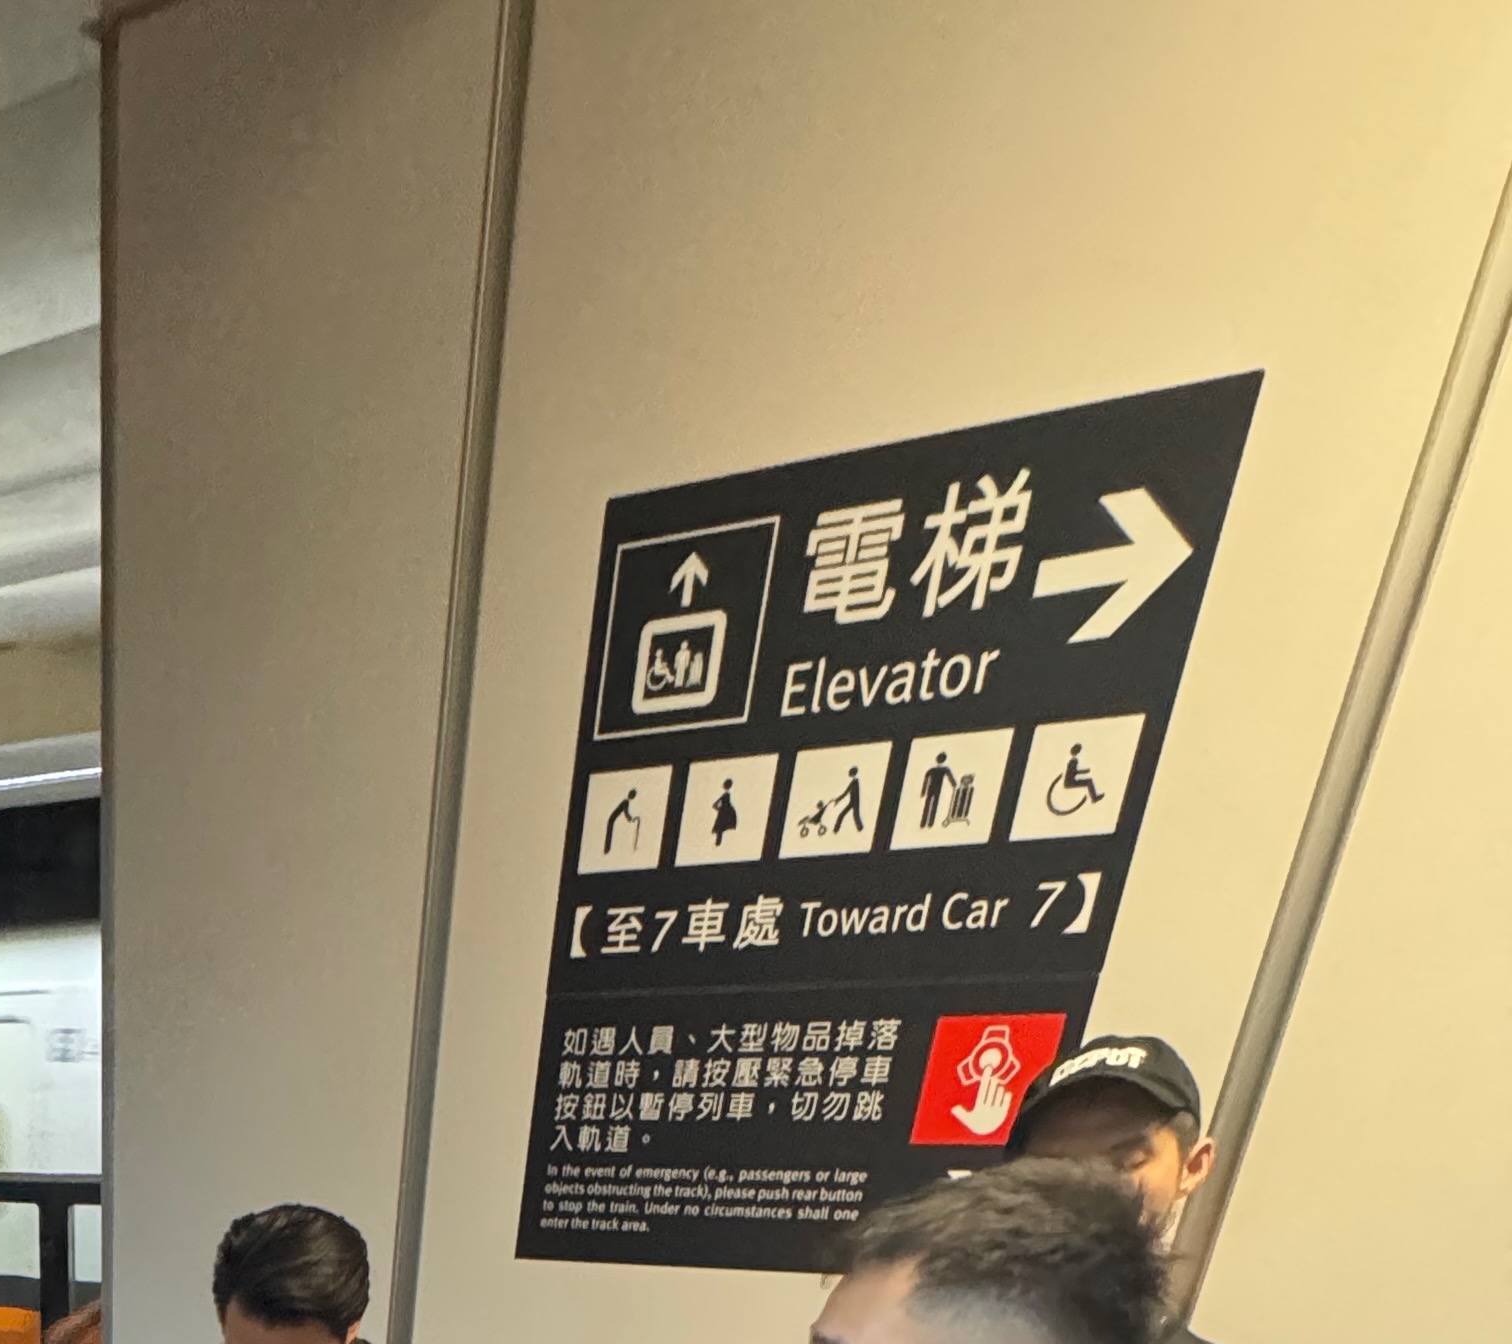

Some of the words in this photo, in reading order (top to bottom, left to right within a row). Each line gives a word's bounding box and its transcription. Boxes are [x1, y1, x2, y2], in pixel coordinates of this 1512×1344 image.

[800, 467, 1032, 625] 電梯
[780, 645, 1001, 718] Elevator
[800, 893, 933, 938] Toward
[941, 893, 1010, 931] Car
[562, 1019, 903, 1056] 如遇人員、大型物品掉落
[558, 1055, 894, 1090] 軌道時，請按壓緊急停車
[553, 1091, 886, 1123] 按鈕以暫停列車，切勿跳
[549, 1123, 652, 1155] 入軌道。
[547, 1163, 558, 1177] In
[561, 1164, 581, 1178] the
[584, 1165, 616, 1179] event
[619, 1164, 634, 1178] of
[635, 1167, 700, 1182] emergency
[738, 1169, 811, 1184] passengers
[815, 1170, 831, 1183] or
[834, 1168, 868, 1185] large
[544, 1180, 586, 1196] objects
[587, 1181, 651, 1199] obstructing
[653, 1182, 673, 1197] the
[714, 1184, 757, 1201] please
[757, 1187, 788, 1202] push
[791, 1188, 819, 1200] rear
[819, 1187, 863, 1202] button
[540, 1217, 570, 1229] enter
[571, 1217, 589, 1230] the
[591, 1217, 619, 1231] track
[621, 1220, 650, 1232] area.
[542, 1200, 555, 1212] to
[558, 1200, 583, 1215] stop
[587, 1200, 606, 1213] the
[609, 1201, 638, 1214] train.
[644, 1202, 681, 1215] Under
[683, 1205, 700, 1216] no
[704, 1203, 793, 1219] circumstances
[797, 1205, 829, 1220] shall
[833, 1208, 859, 1221] one
